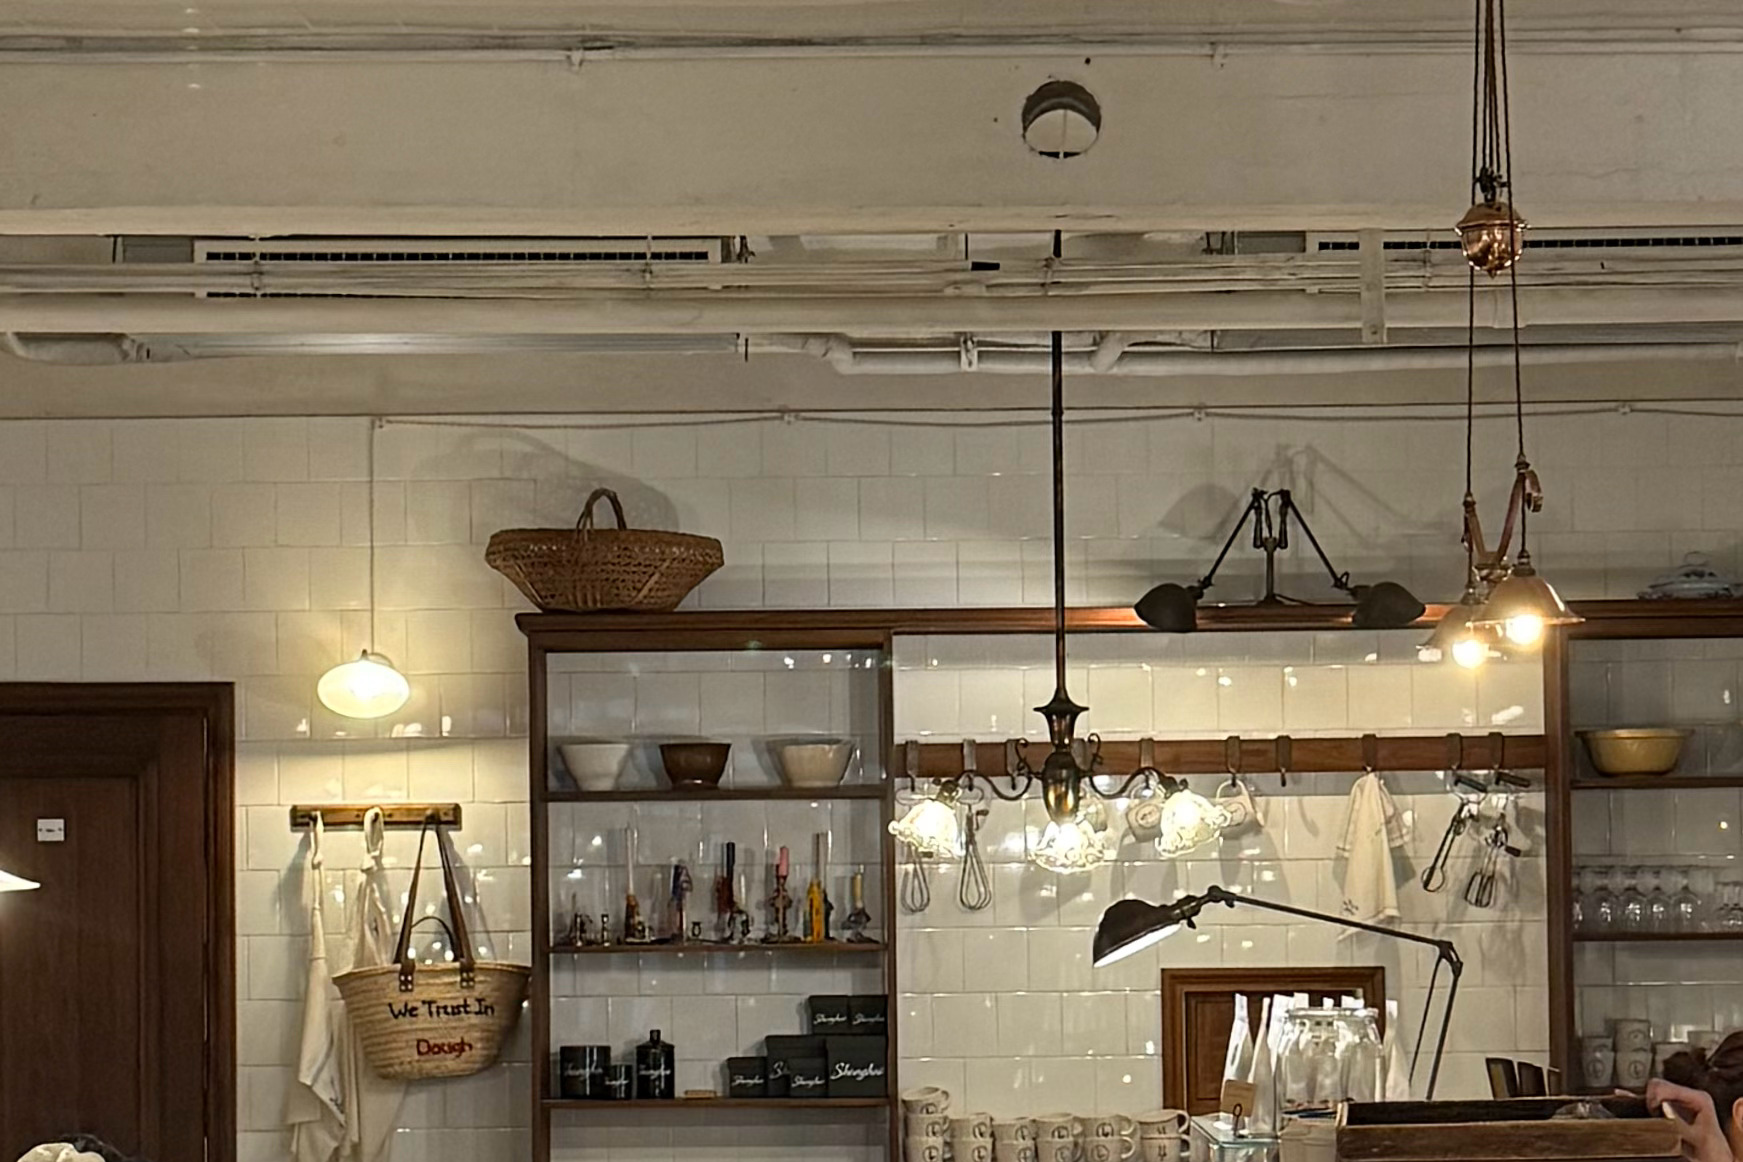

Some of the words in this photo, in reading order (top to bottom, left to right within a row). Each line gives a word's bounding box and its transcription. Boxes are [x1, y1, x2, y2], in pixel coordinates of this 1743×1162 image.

[388, 1001, 419, 1020] We
[421, 998, 472, 1018] Trust
[474, 998, 495, 1017] In
[416, 1037, 473, 1059] Dough
